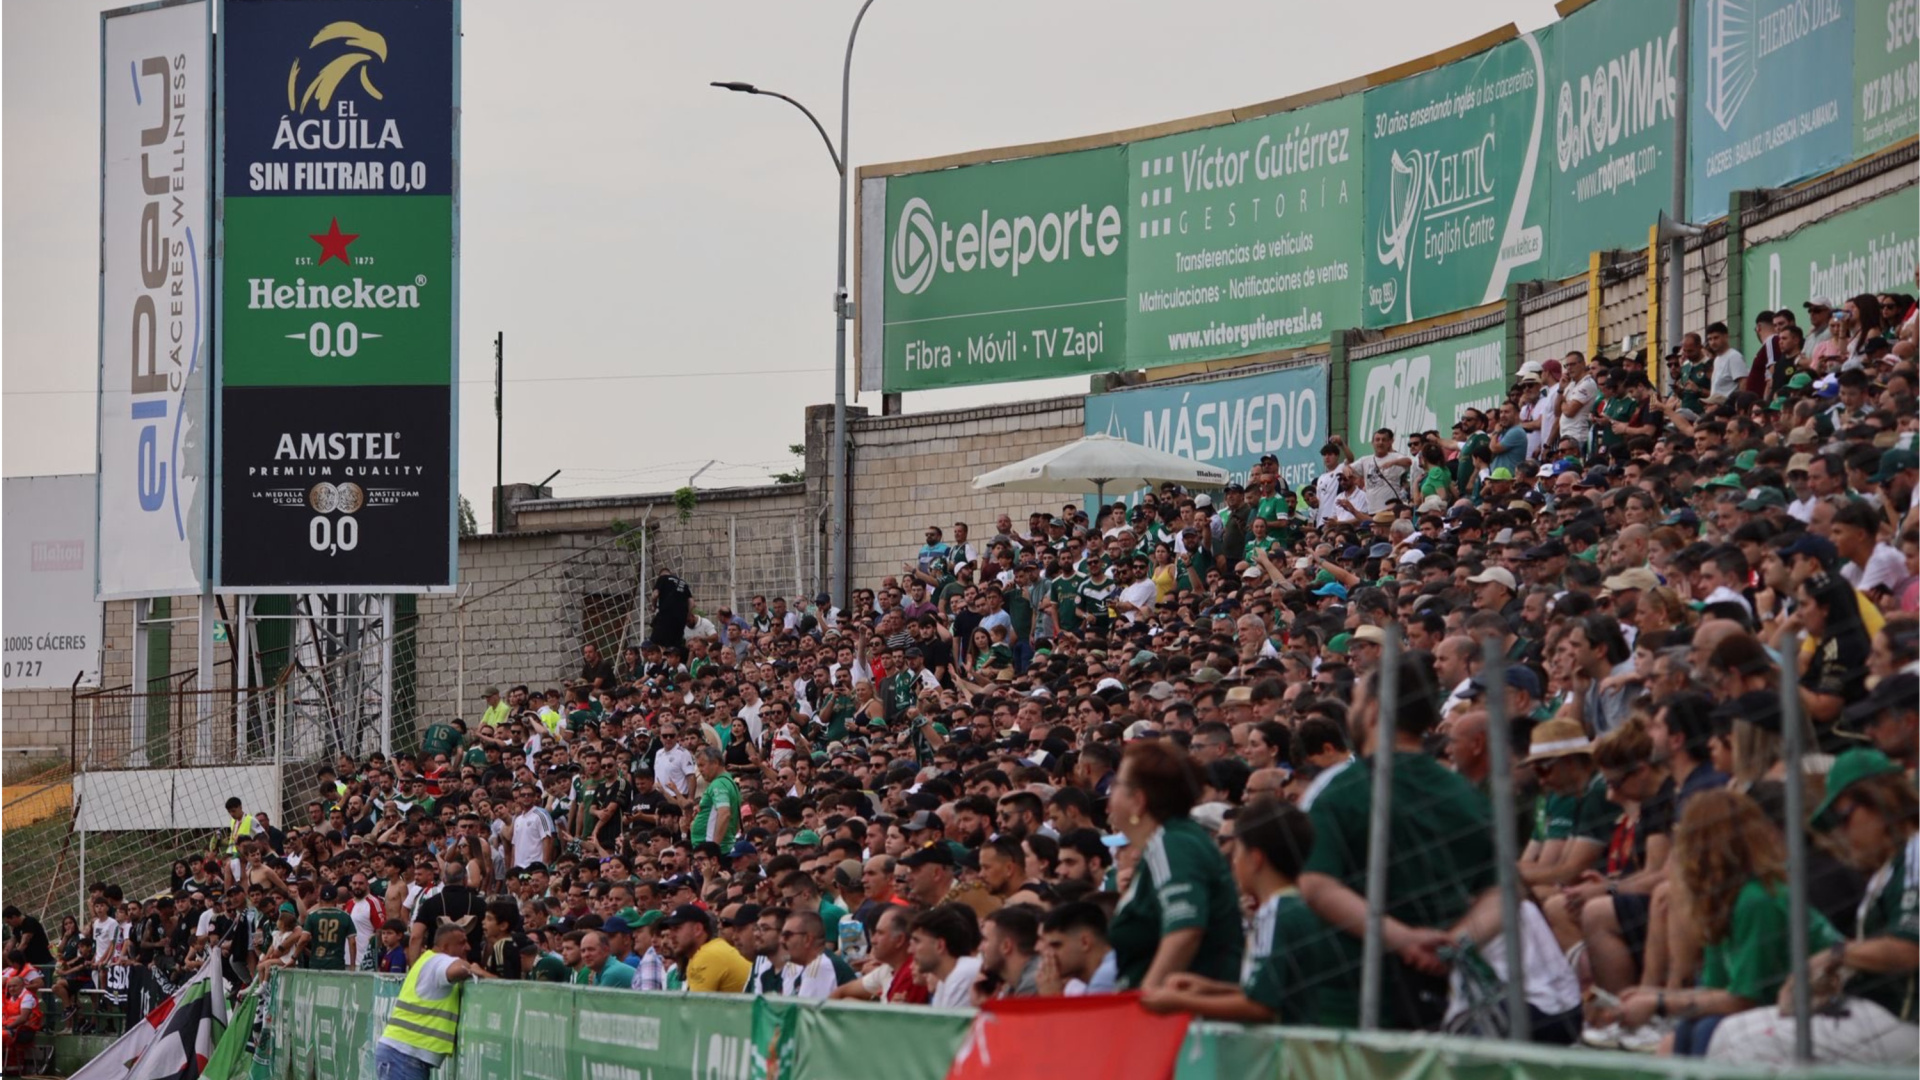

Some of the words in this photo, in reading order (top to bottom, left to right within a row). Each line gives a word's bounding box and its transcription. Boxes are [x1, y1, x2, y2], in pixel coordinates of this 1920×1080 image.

[1758, 0, 1810, 58] HIERROS
[337, 100, 358, 117] EL
[1374, 112, 1387, 139] 30
[1388, 110, 1409, 135] años
[1409, 94, 1451, 129] enseñando
[1453, 84, 1475, 118] inglés
[172, 54, 186, 227] WELLNESS
[272, 114, 404, 150] ÁGUILA
[249, 162, 289, 191] SIN
[294, 161, 384, 191] FILTRAR
[390, 161, 426, 192] 0,0
[1182, 144, 1250, 193] Víctor
[1254, 122, 1349, 180] Gutiérrez
[1424, 131, 1495, 210] KELTIC
[1179, 177, 1348, 234] GESTORÍA
[940, 204, 1121, 277] teleporte
[1176, 244, 1250, 273] Transferencias
[1253, 240, 1266, 261] de
[1268, 231, 1313, 258] vehículos
[1424, 219, 1461, 265] English
[1462, 214, 1495, 250] Centre
[295, 257, 313, 266] EST.
[1139, 283, 1220, 313] Matriculaciones
[1229, 265, 1301, 300] Notificaciones
[1303, 266, 1315, 288] de
[1317, 260, 1348, 283] ventas
[309, 322, 358, 357] 0.0
[905, 340, 951, 371] Fibra
[968, 331, 1017, 365] Móvil
[1032, 328, 1057, 359] TV
[1062, 321, 1103, 362] Zapi
[1168, 307, 1323, 350] www.victorgutierrezsl.es
[1143, 388, 1317, 461] MÁSMEDIO
[274, 432, 401, 460] AMSTEL
[249, 466, 332, 476] PREMIUM
[345, 466, 423, 476] QUALITY
[309, 515, 359, 557] 0,0
[4, 636, 33, 651] 10005
[36, 632, 86, 650] CÁCERES
[16, 661, 43, 677] 727
[433, 725, 450, 740] 16
[318, 918, 340, 943] 92
